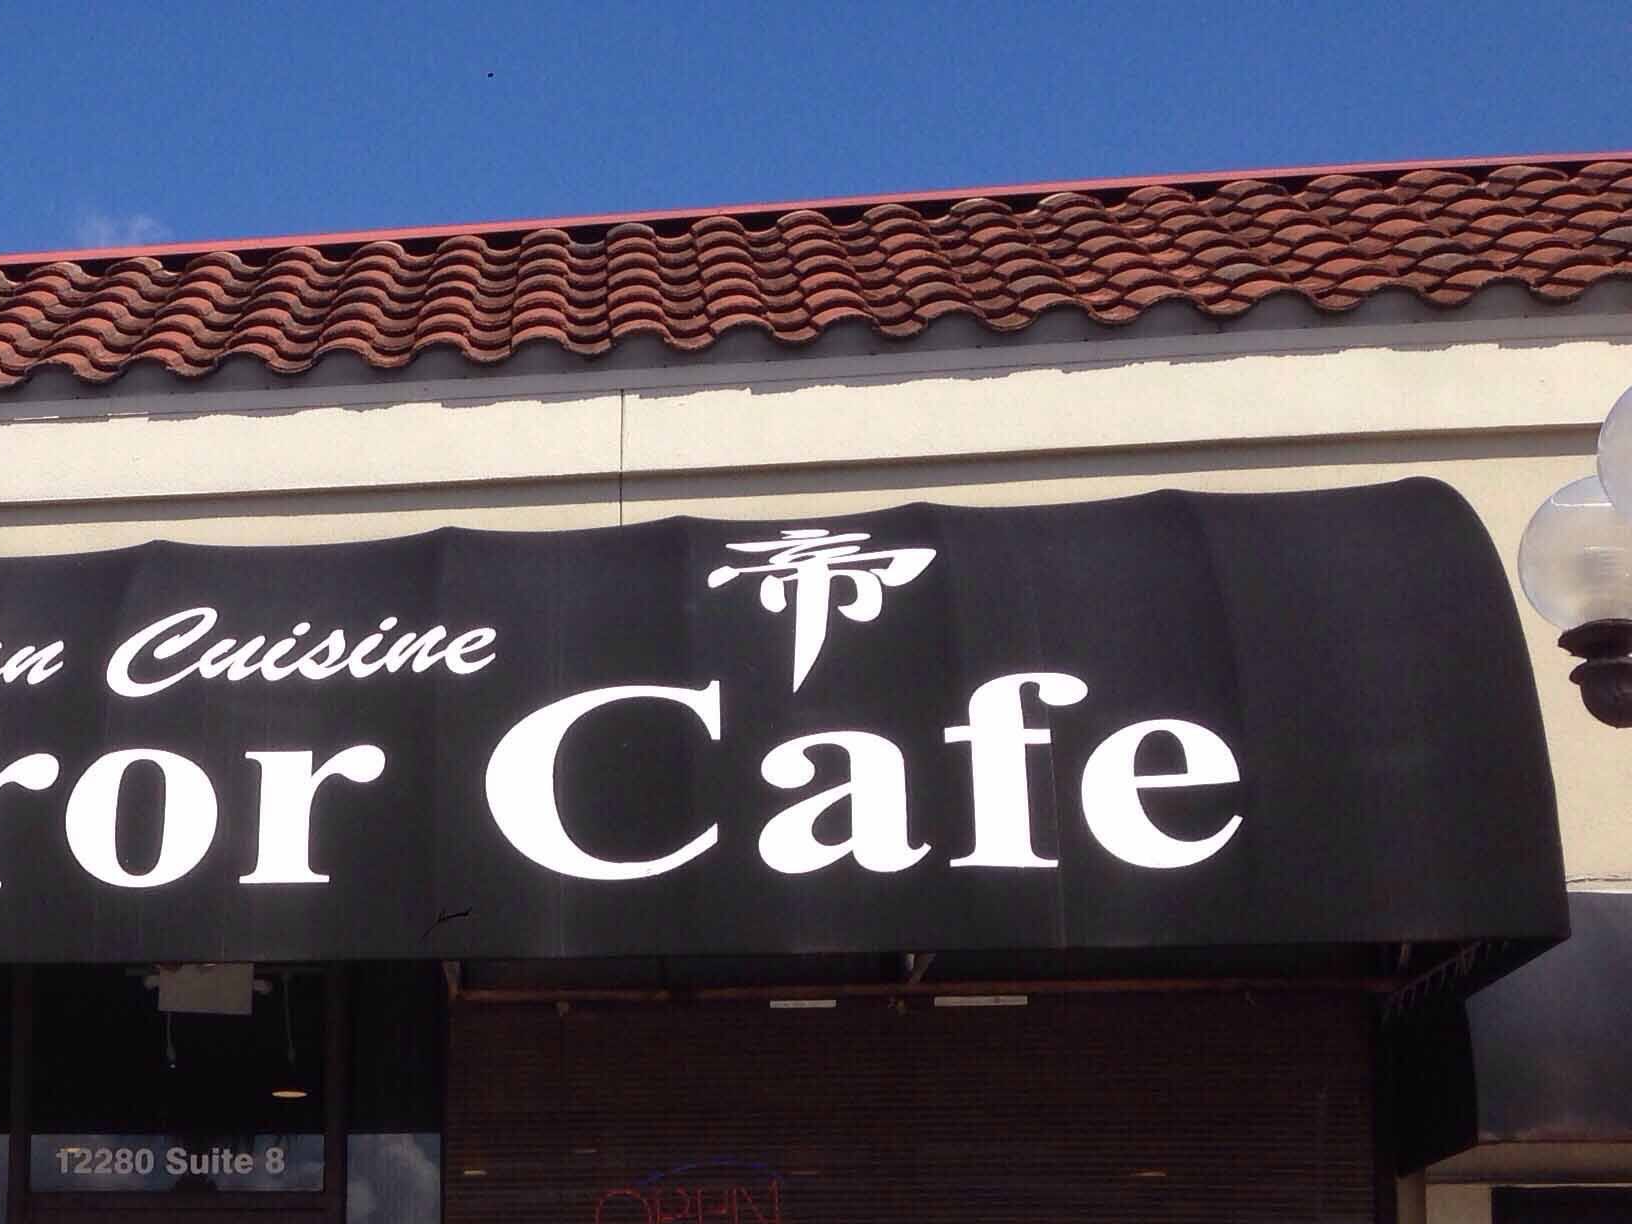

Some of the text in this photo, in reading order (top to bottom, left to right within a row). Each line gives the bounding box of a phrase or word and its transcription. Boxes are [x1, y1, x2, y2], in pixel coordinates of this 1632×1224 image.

[106, 607, 496, 697] Cuisine
[707, 529, 937, 693] 帝
[485, 672, 1243, 881] Cafe
[56, 1147, 286, 1175] 12280 Suite 8
